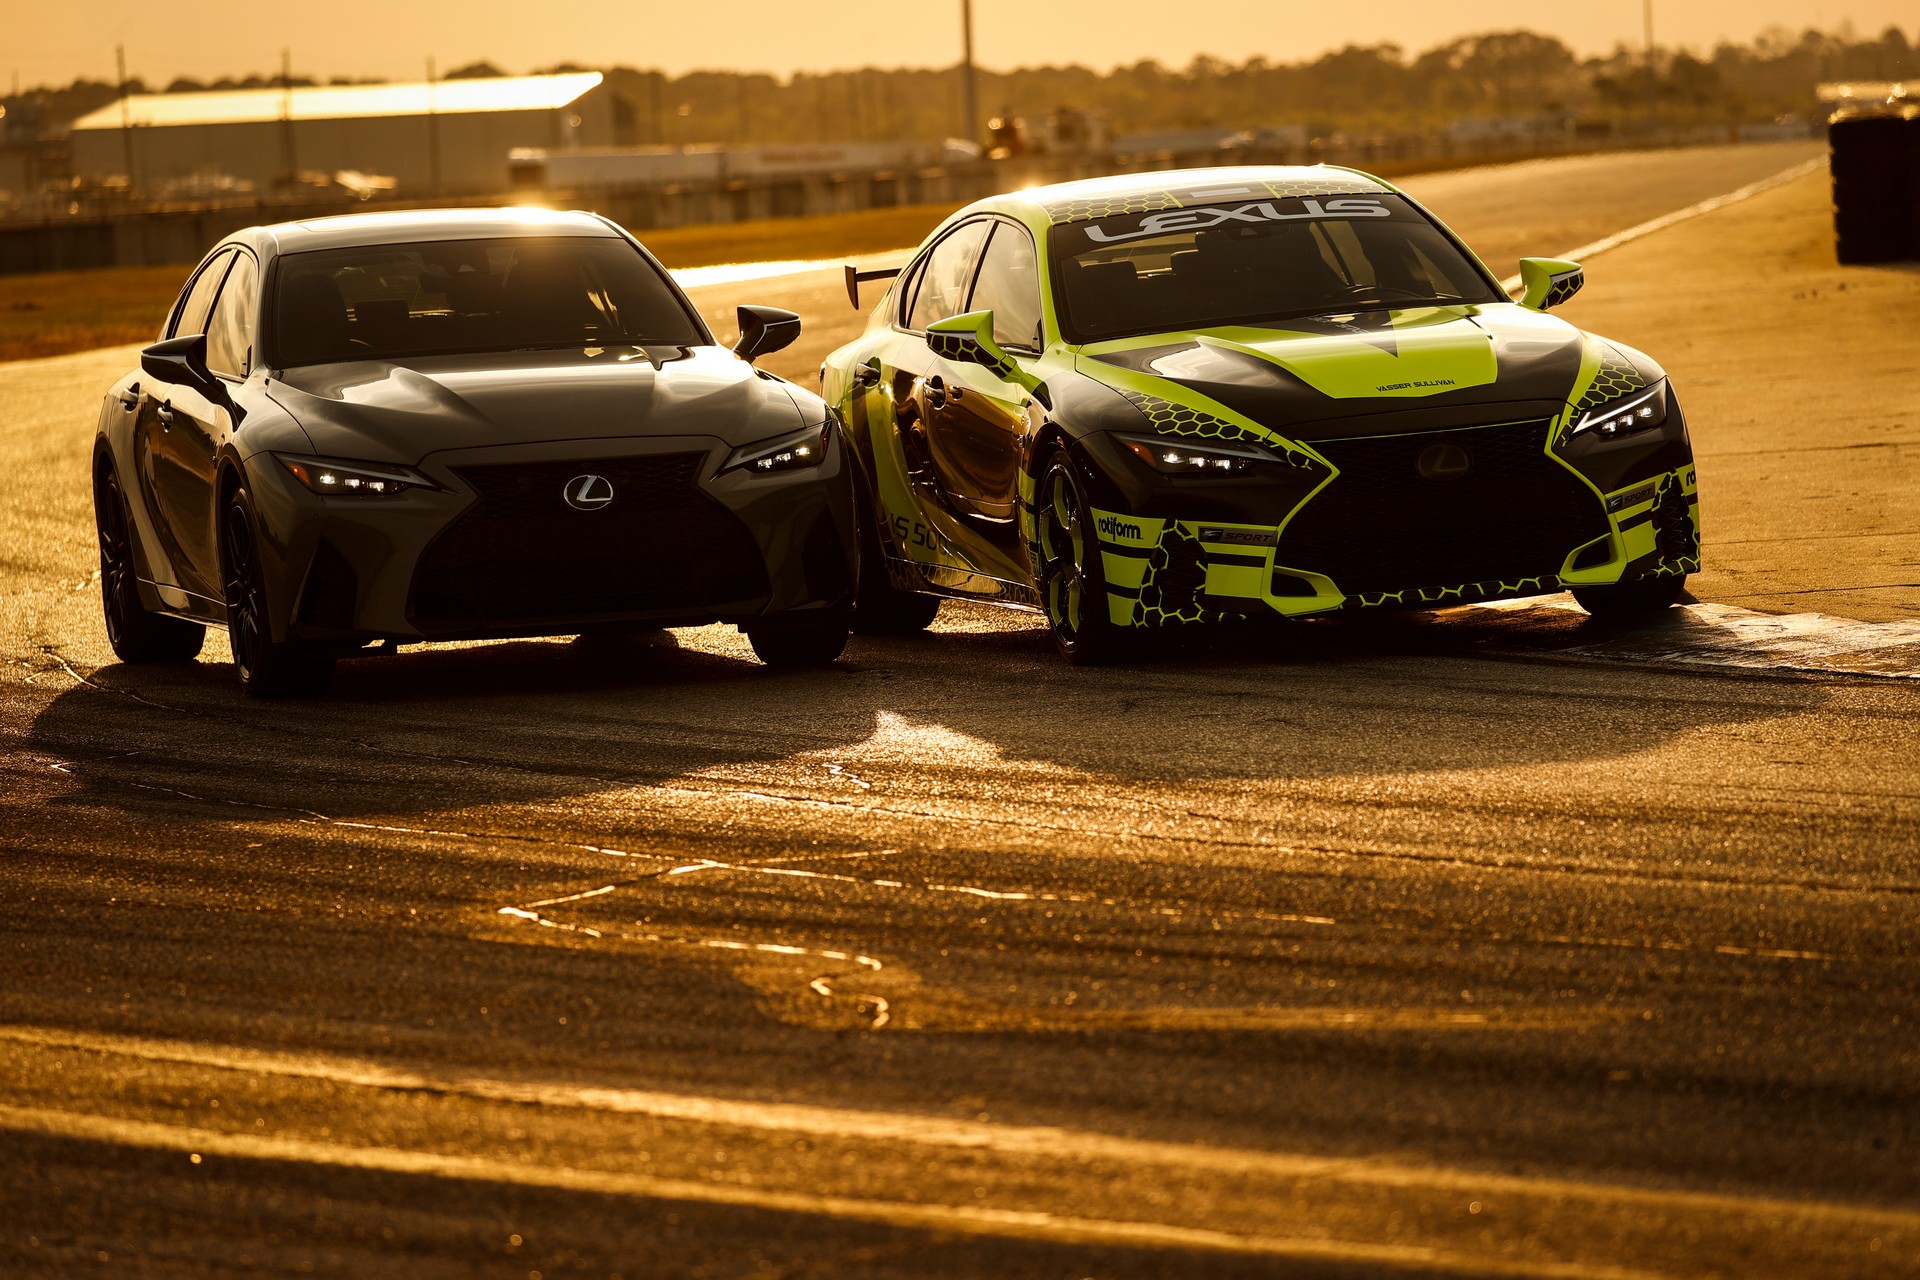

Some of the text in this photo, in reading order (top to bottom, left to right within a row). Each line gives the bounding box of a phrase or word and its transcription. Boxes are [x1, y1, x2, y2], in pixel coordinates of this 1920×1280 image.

[1083, 199, 1391, 243] LEXUS
[1376, 379, 1456, 392] VASSER SULLIVAN
[1623, 488, 1653, 504] SPORT
[890, 513, 947, 555] IS 500
[1098, 516, 1141, 541] rotiform
[1224, 532, 1273, 542] SPORT
